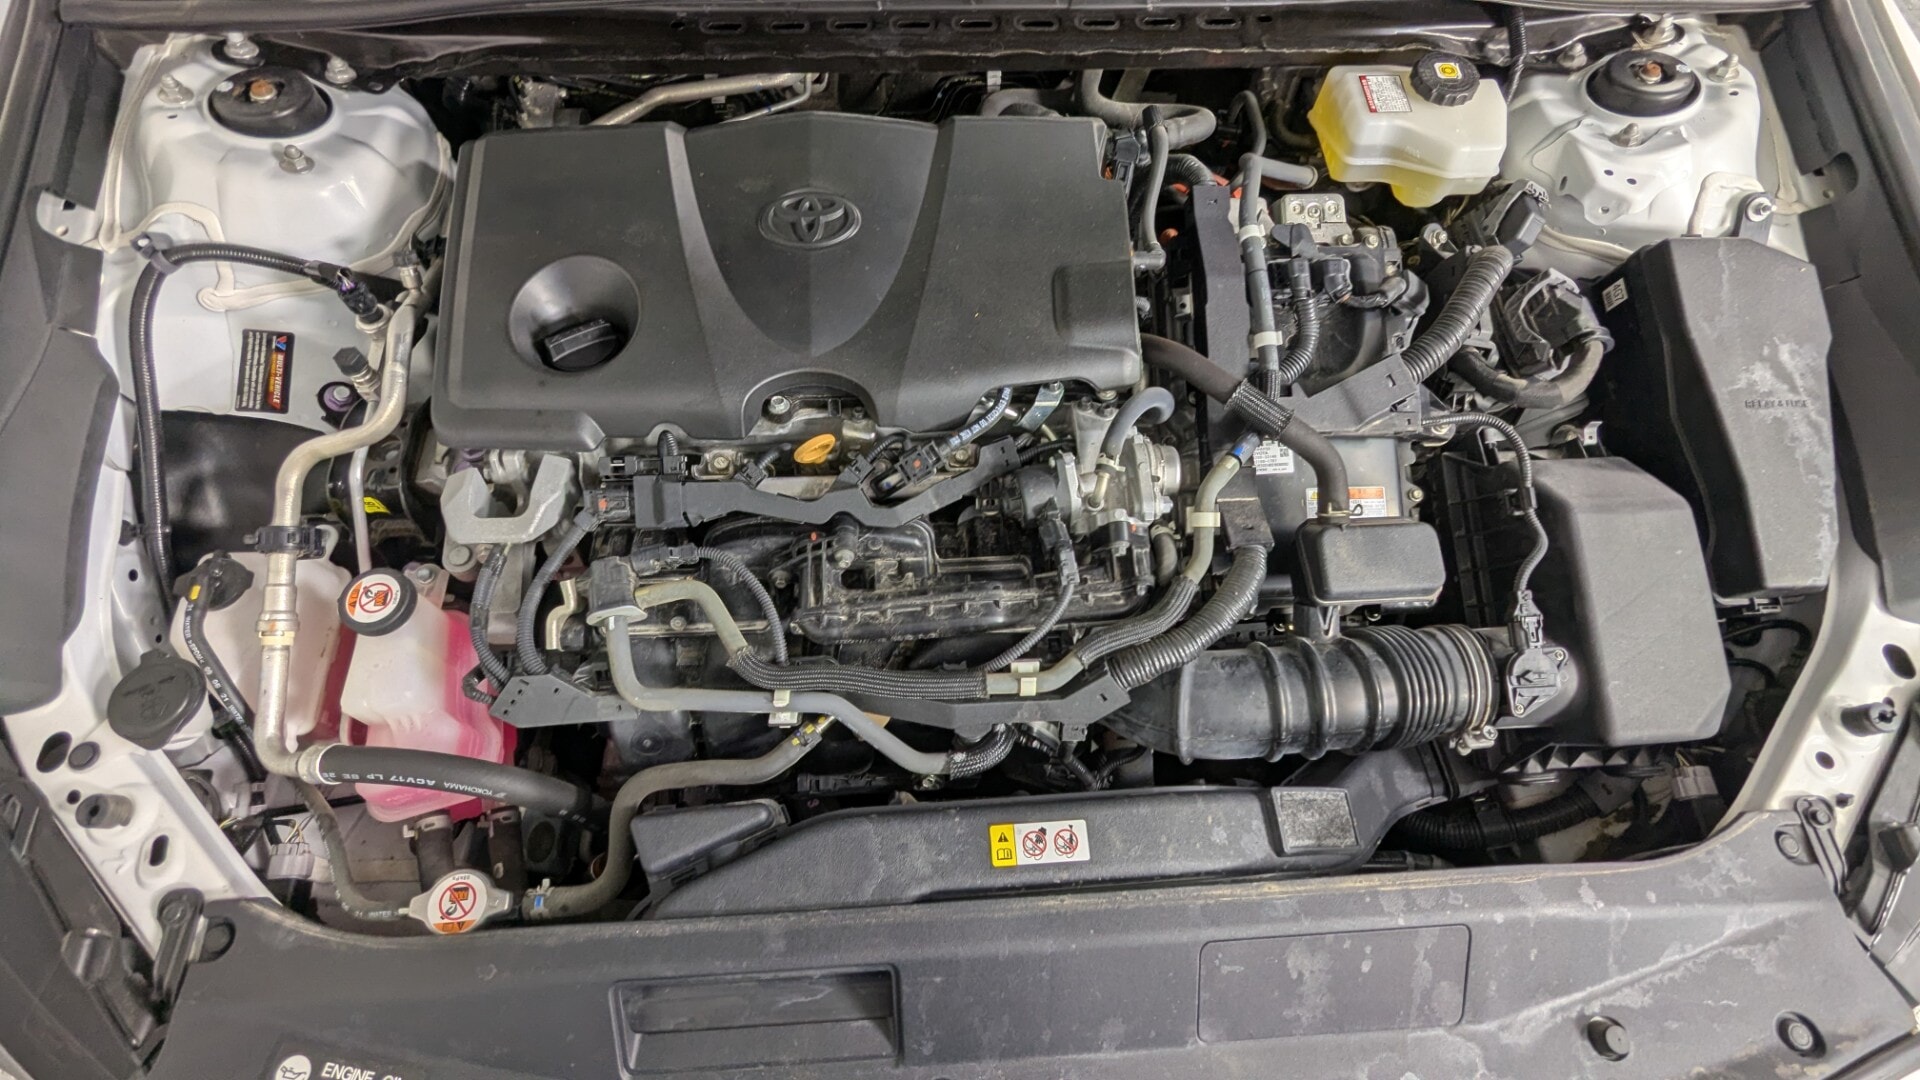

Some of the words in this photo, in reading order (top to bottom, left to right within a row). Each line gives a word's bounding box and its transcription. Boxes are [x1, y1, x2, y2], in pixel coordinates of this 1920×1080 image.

[273, 354, 284, 403] MULTI-VEHICLE
[390, 775, 436, 787] ACV17
[443, 781, 493, 797] YOKOHAMA
[321, 1062, 376, 1080] ENGINE
